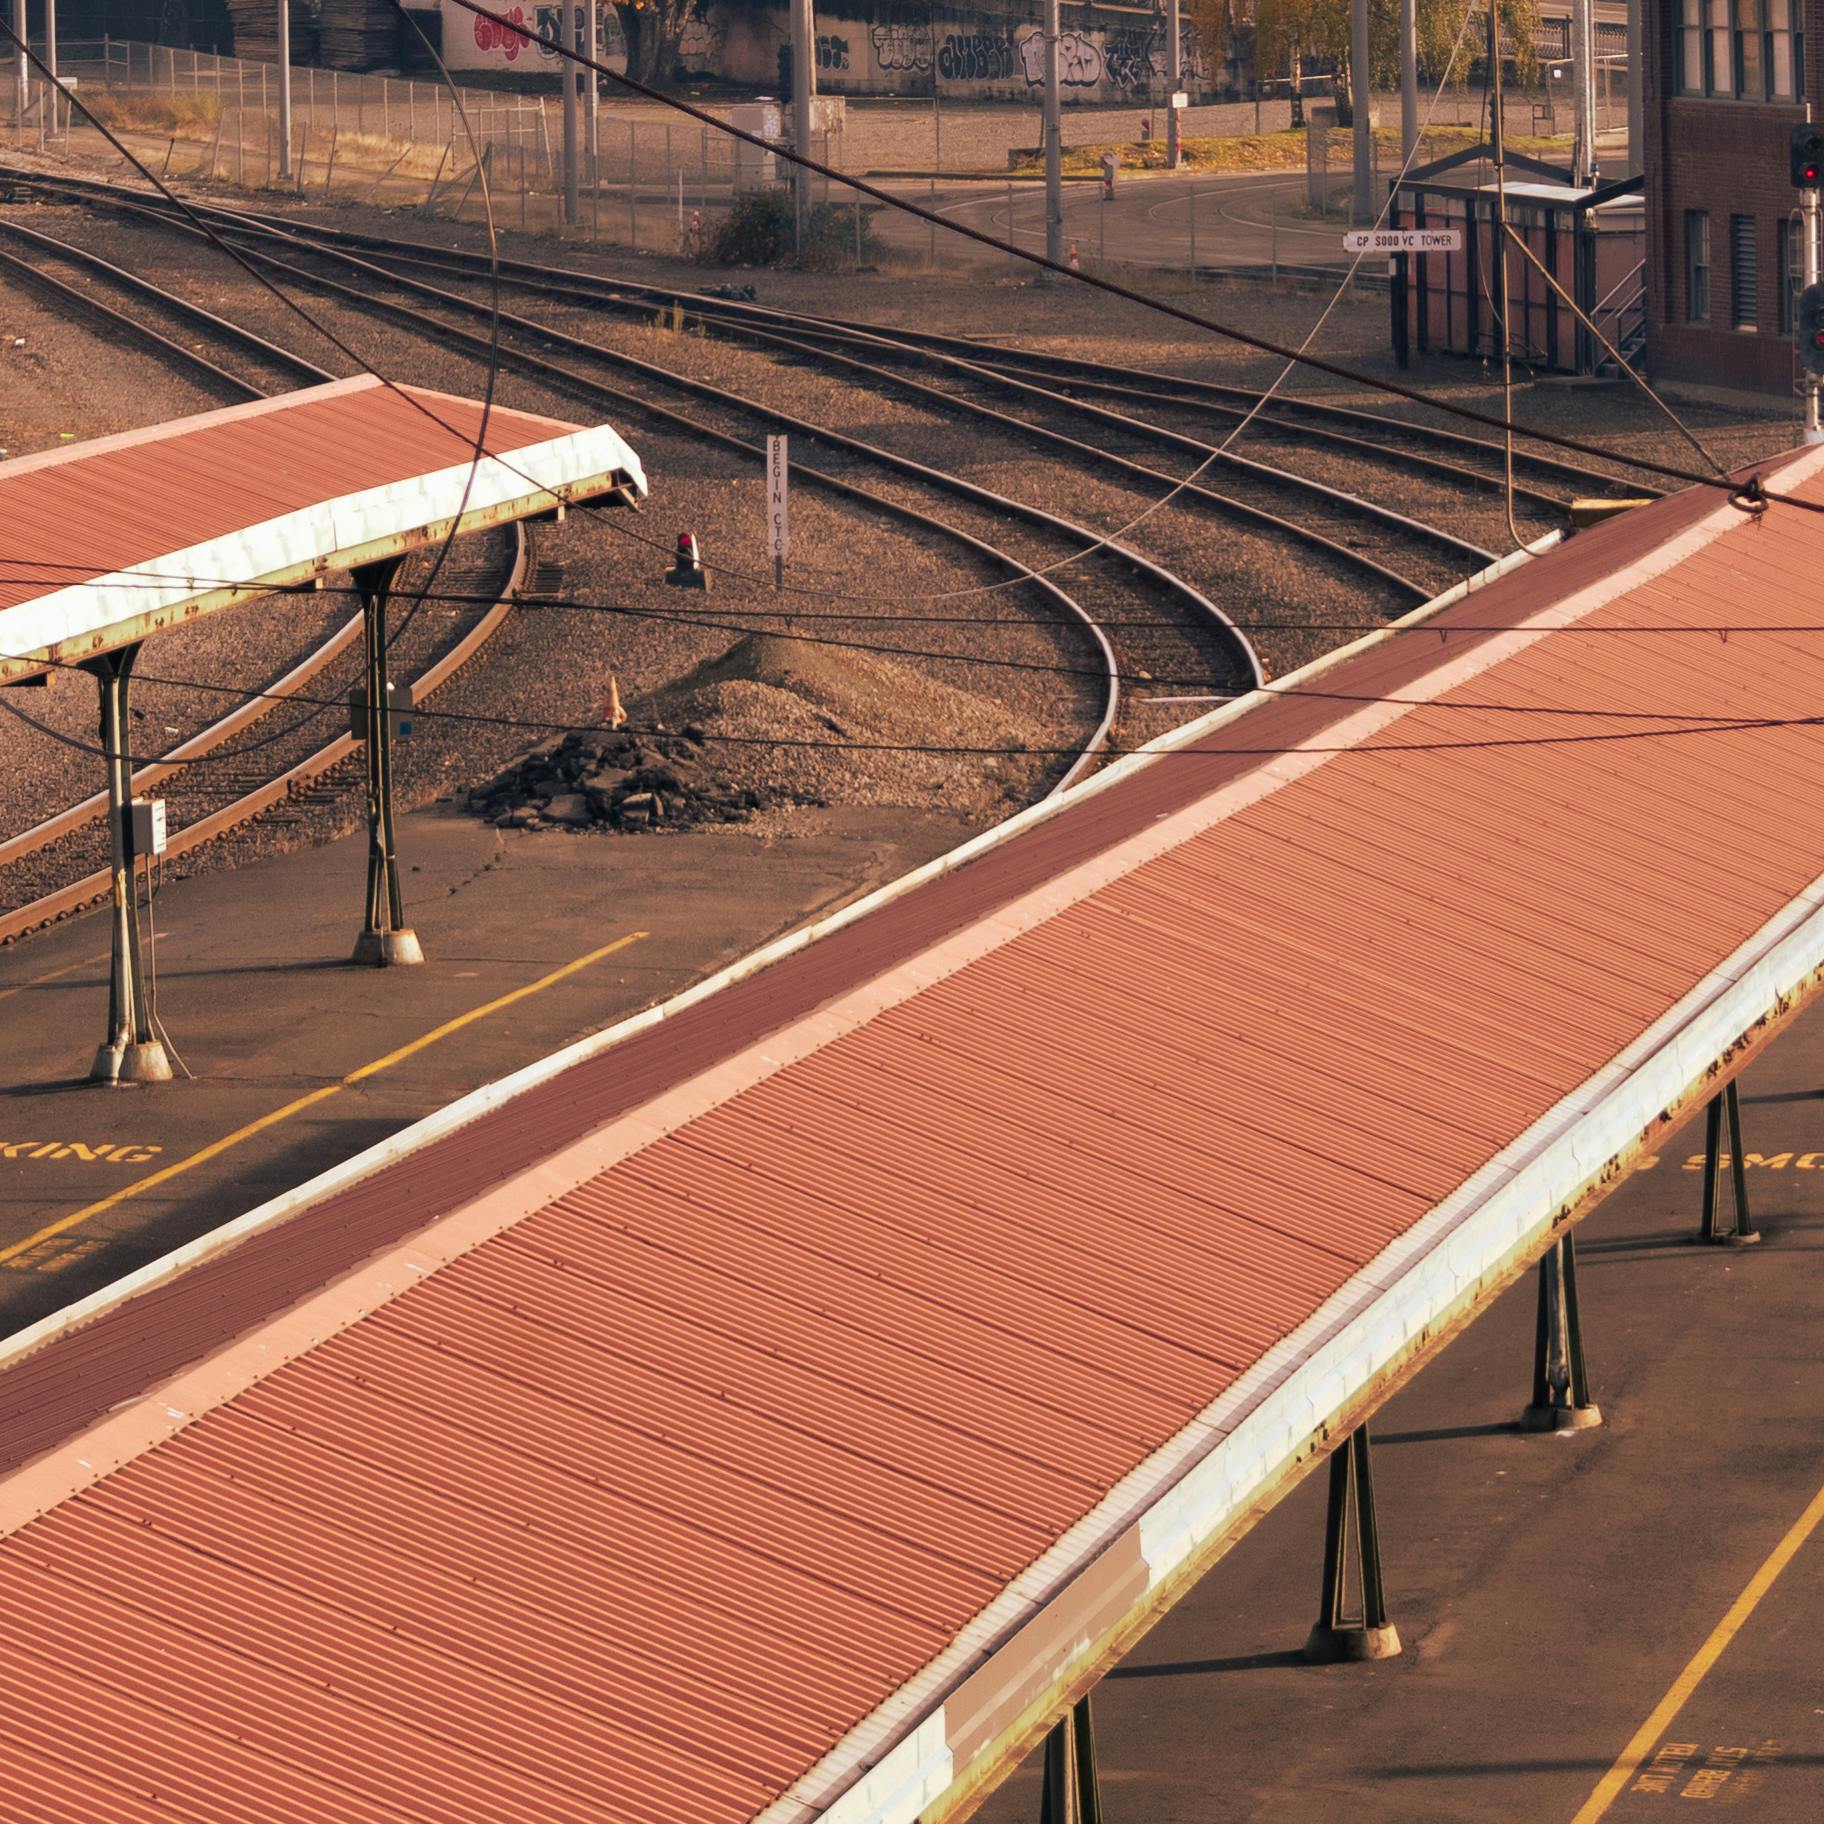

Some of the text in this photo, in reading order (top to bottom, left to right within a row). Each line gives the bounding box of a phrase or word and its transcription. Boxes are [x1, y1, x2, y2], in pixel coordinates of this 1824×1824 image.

[1356, 236, 1369, 247] CP
[1402, 236, 1414, 246] VC
[1421, 235, 1452, 246] TOWER
[772, 439, 782, 551] BEGIN CTC
